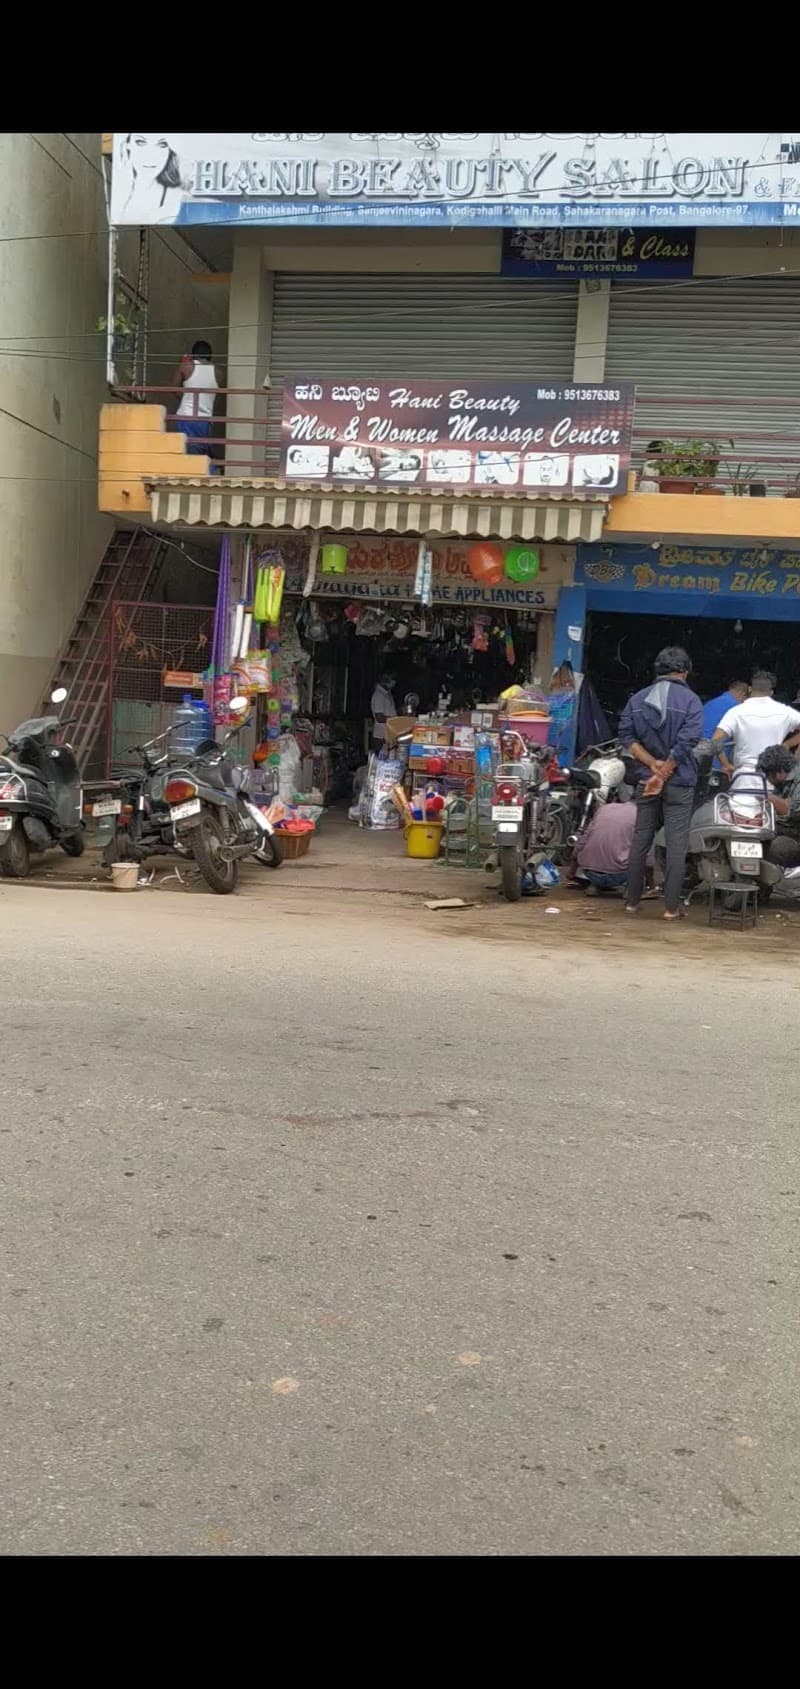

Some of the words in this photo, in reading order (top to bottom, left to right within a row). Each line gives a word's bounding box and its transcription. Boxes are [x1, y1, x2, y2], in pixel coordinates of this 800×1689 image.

[191, 158, 317, 197] HANI
[327, 151, 556, 199] BEAUTY
[561, 156, 749, 199] SALON
[754, 177, 773, 198] &
[779, 177, 800, 198] F
[532, 205, 560, 218] Road,
[649, 205, 676, 217] Post,
[783, 204, 800, 216] M
[622, 236, 635, 257] &
[639, 235, 690, 260] Class
[556, 263, 575, 272] Mob
[294, 384, 323, 400] ಹನಿ
[389, 388, 442, 409] Hani
[448, 390, 521, 413] Beauty
[537, 388, 556, 400] Mob
[564, 388, 621, 402] 9513676383
[290, 415, 338, 441] Men
[343, 420, 361, 442] &
[367, 417, 440, 445] Women
[448, 415, 545, 451] Massage
[550, 417, 621, 448] Center
[631, 562, 721, 594] Dream
[729, 571, 777, 595] Bike
[455, 586, 545, 604] APPLIANCES
